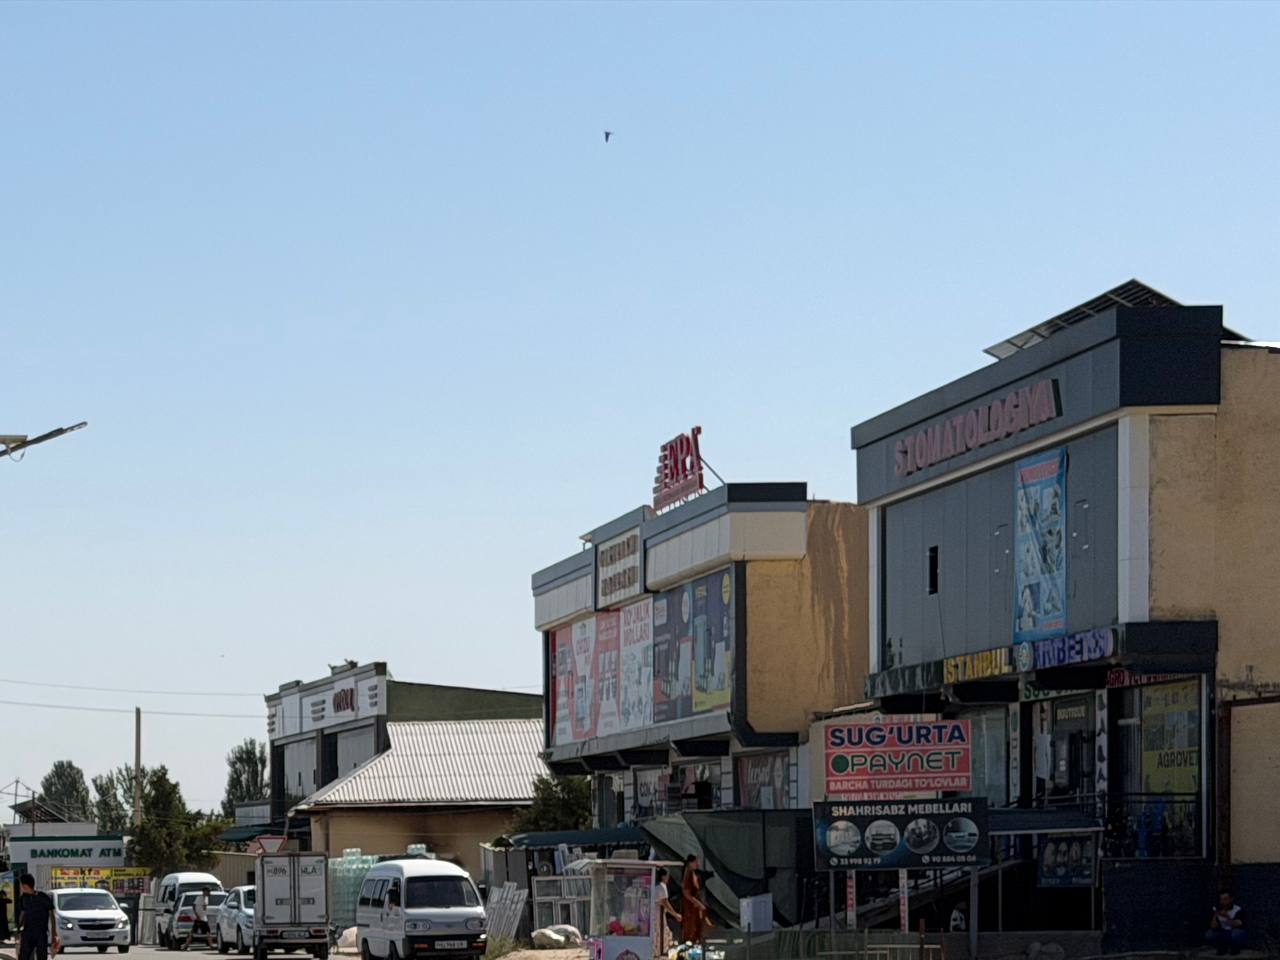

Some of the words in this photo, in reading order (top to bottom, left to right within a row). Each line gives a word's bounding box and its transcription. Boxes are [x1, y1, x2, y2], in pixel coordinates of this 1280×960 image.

[895, 378, 1063, 477] STOMATOLOGIYA
[944, 648, 1012, 684] ISTANBUL
[830, 724, 966, 747] SUG'URTA
[831, 804, 905, 817] SHAHRISABZ
[907, 803, 972, 815] MEBELLARI
[30, 848, 93, 858] BANKOMAT
[99, 848, 122, 857] ATM
